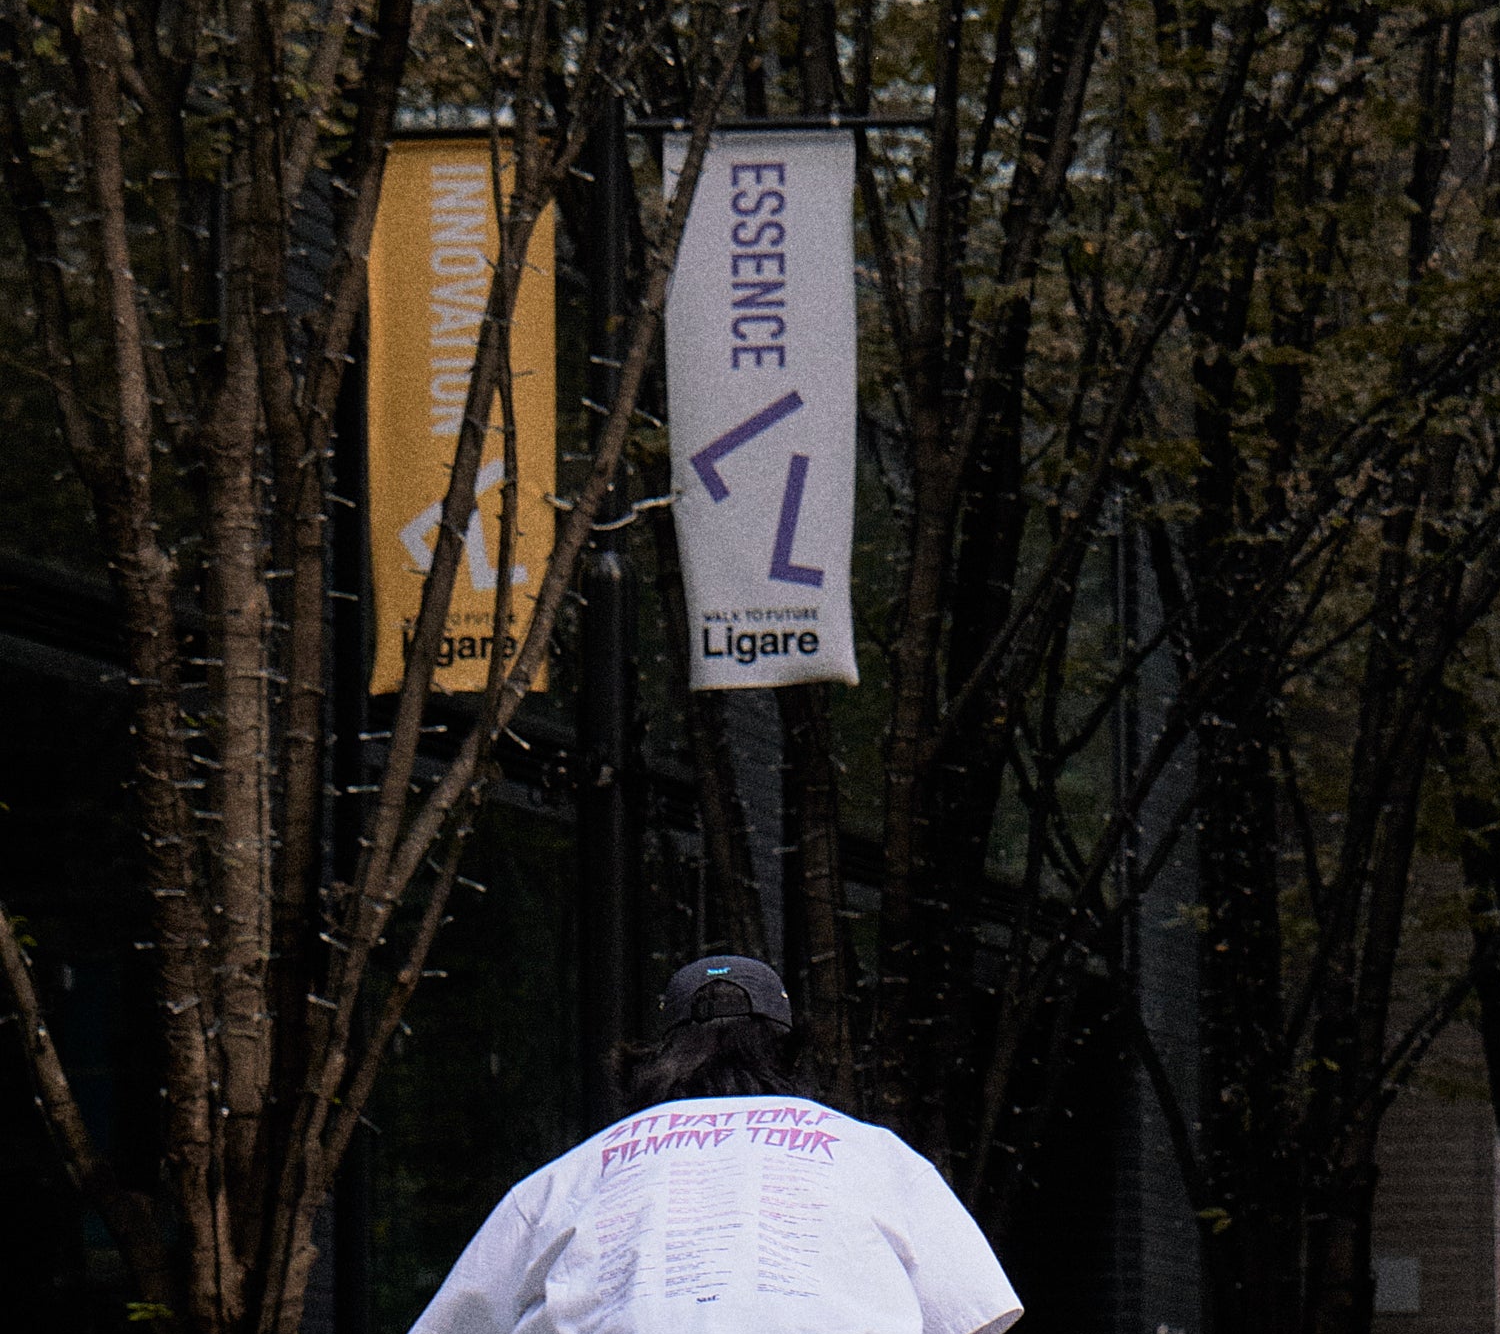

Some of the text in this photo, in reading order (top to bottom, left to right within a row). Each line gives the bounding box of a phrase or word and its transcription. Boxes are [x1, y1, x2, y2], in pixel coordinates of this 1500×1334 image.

[731, 162, 786, 369] ESSENCE
[431, 165, 487, 435] INNOVATION
[745, 609, 762, 622] TO
[403, 630, 517, 667] Lgare
[702, 627, 819, 665] Ligare
[601, 1127, 840, 1177] FILMING TOUR
